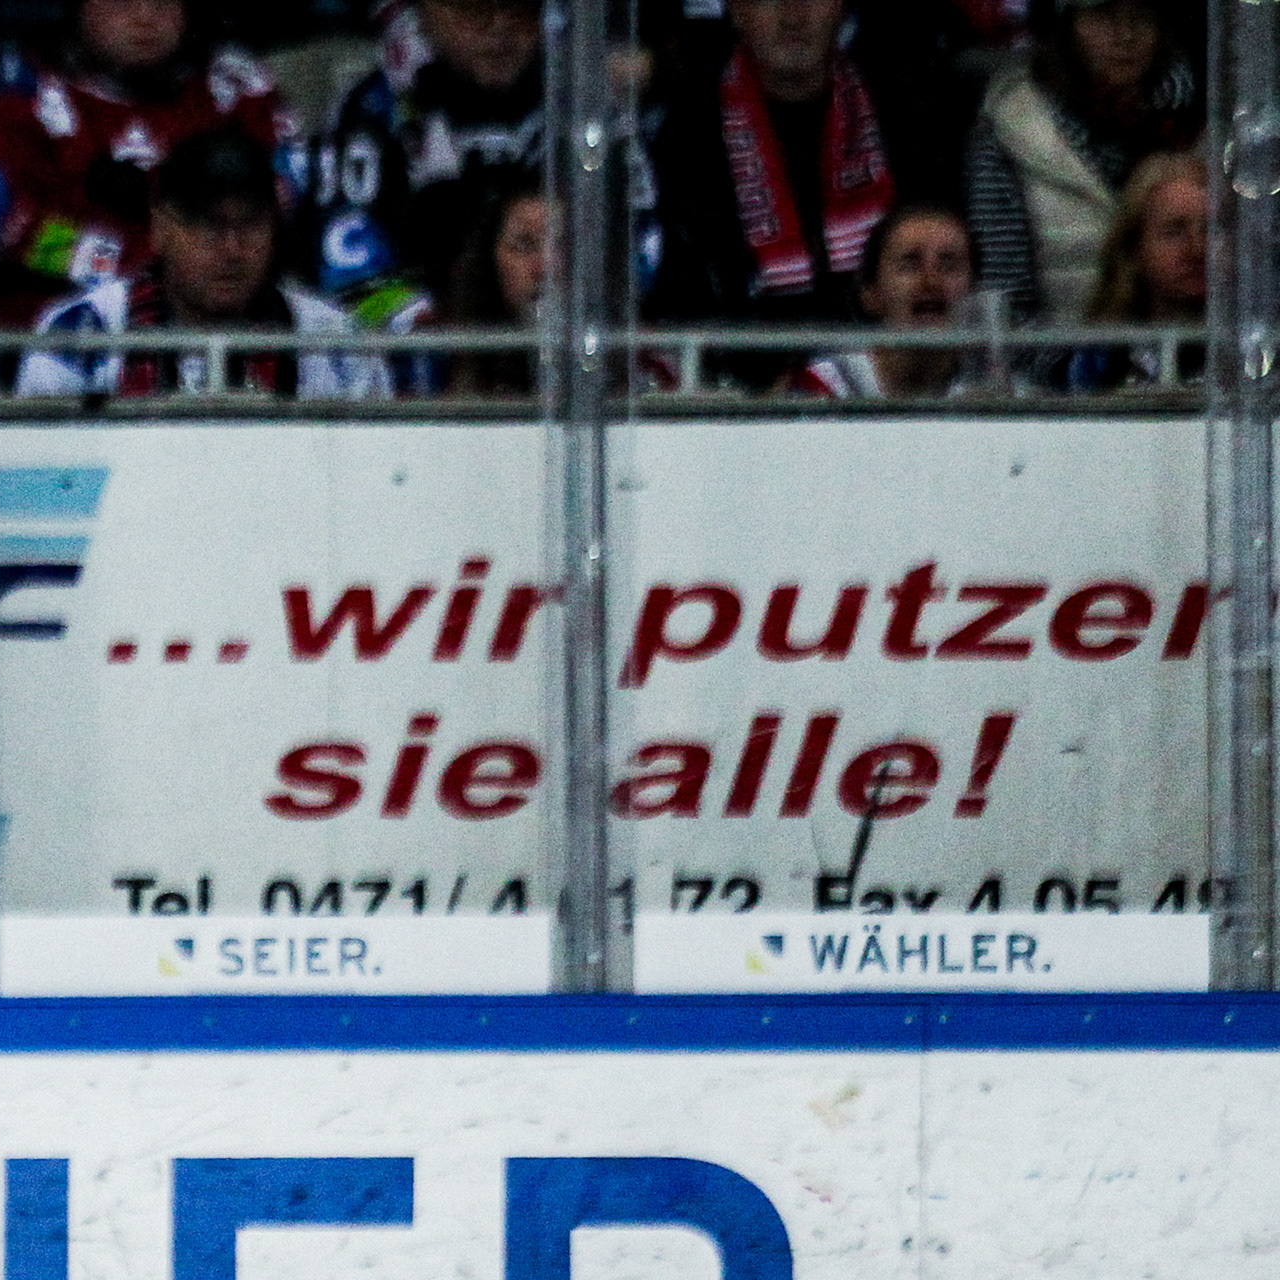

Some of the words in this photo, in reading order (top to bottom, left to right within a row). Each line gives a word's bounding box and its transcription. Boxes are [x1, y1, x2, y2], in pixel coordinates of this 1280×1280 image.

[262, 712, 541, 820] sie
[610, 708, 1020, 820] alle!
[217, 936, 384, 977] SEIER.
[809, 926, 1053, 975] WÄHLER.
